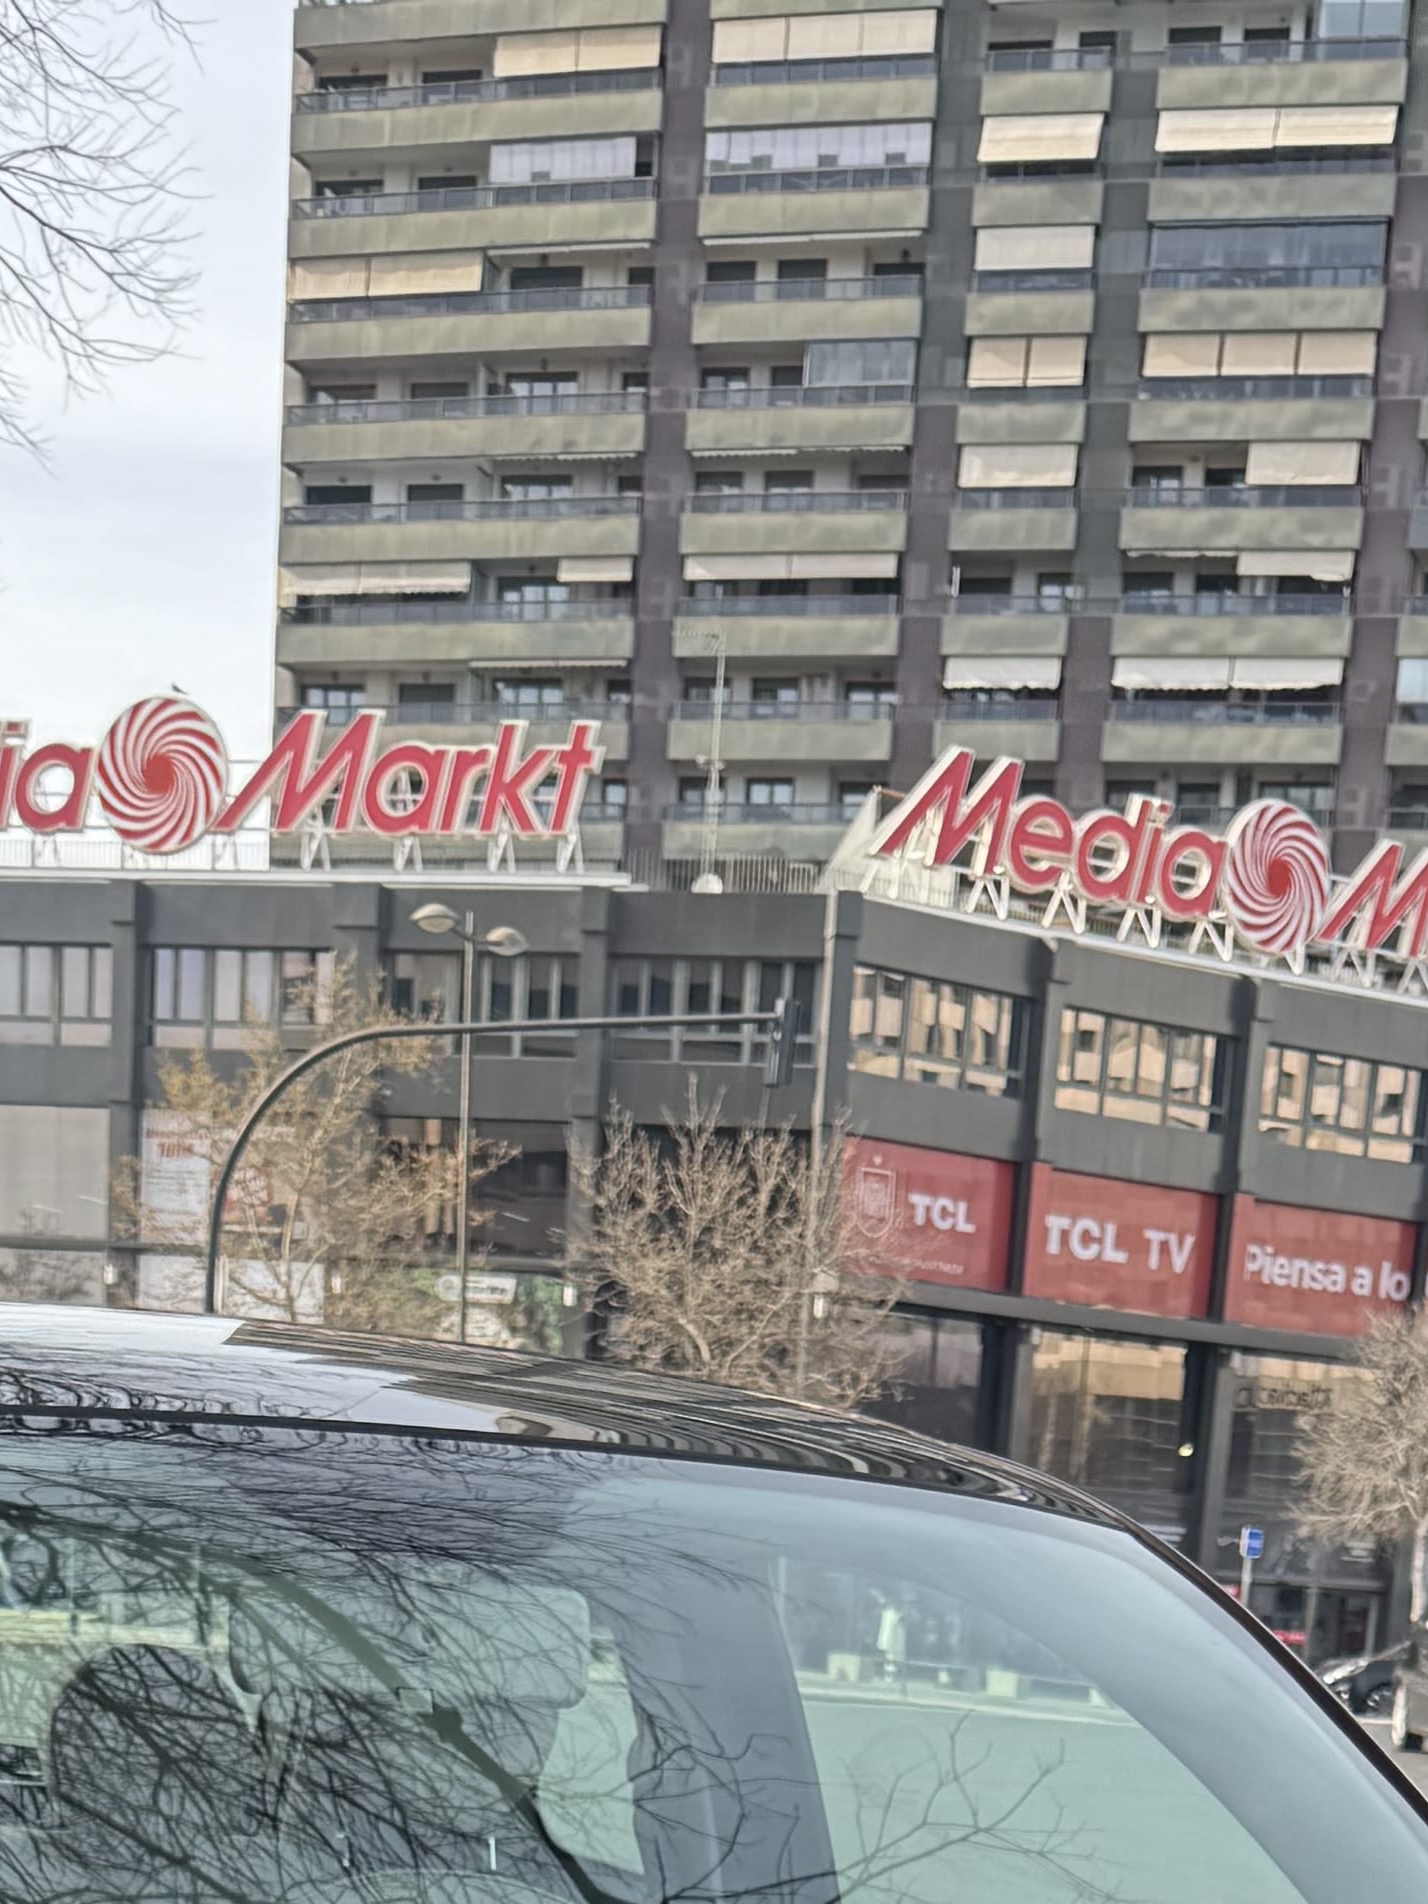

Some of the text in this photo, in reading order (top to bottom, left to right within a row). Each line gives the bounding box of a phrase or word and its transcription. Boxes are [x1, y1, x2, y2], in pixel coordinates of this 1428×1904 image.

[209, 708, 605, 837] Markt
[870, 745, 1228, 919] Media
[907, 1192, 976, 1234] TCL
[1044, 1214, 1196, 1275] TCL TV
[1243, 1243, 1346, 1294] Piensa
[1351, 1265, 1372, 1297] a
[1378, 1260, 1411, 1301] lo
